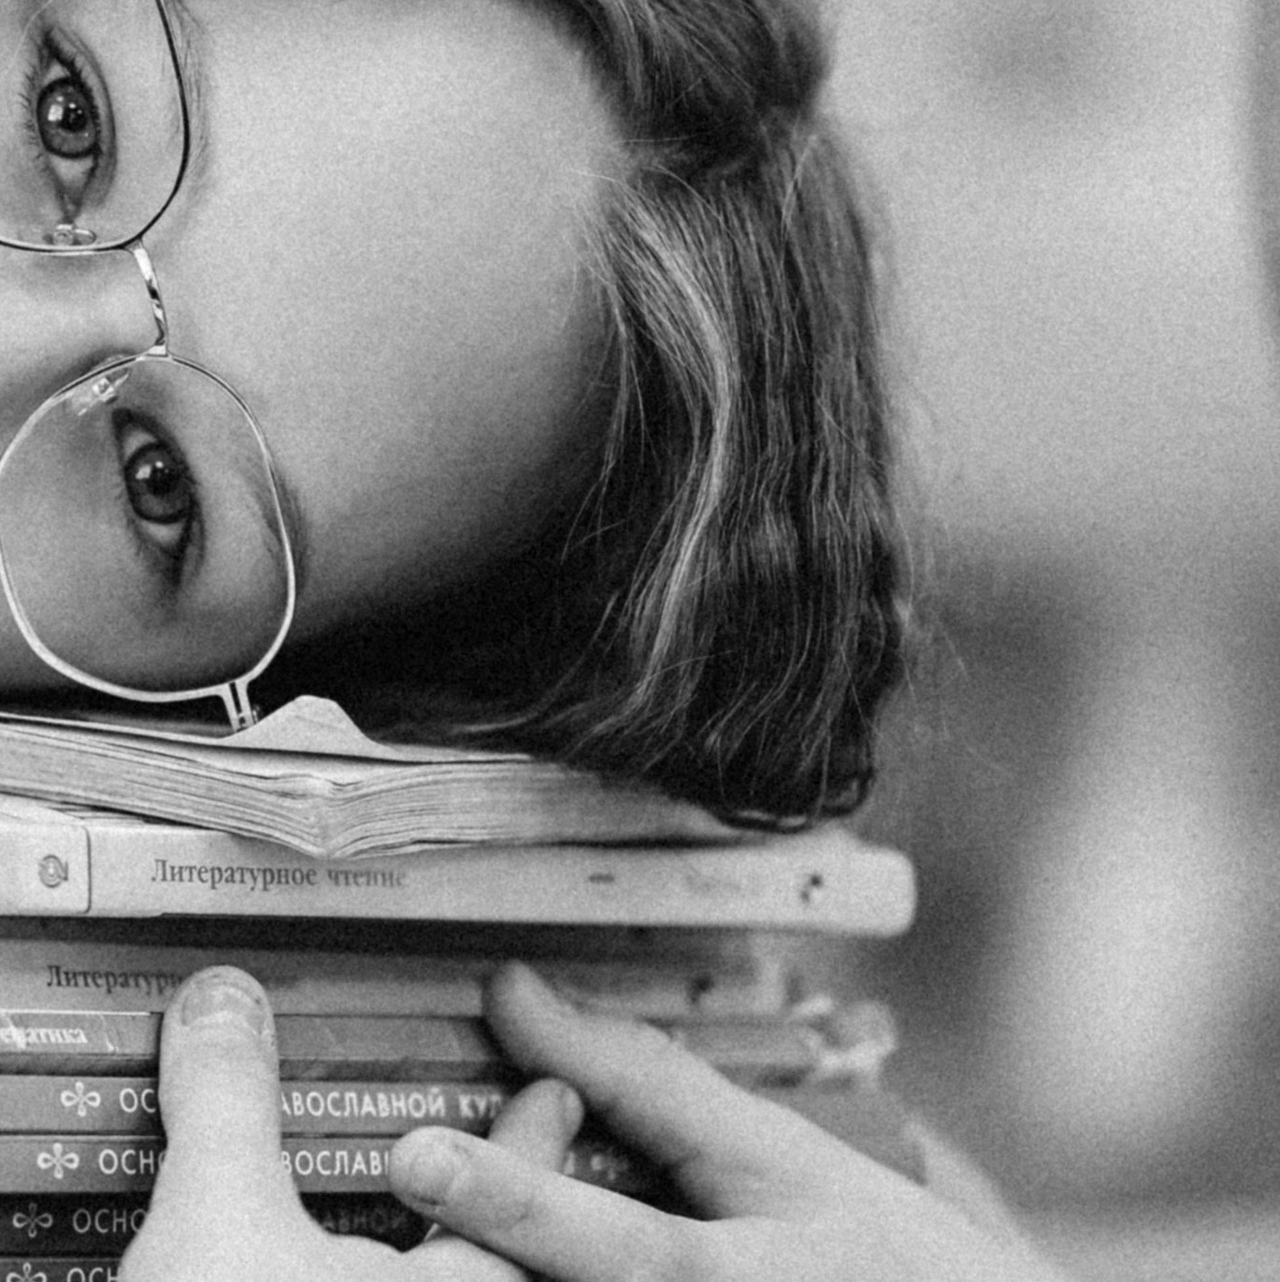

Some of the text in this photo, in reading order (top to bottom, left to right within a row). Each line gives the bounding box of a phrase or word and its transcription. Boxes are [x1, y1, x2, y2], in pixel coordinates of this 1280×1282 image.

[150, 858, 405, 892] Литературное чтение
[119, 1087, 157, 1113] ОС
[280, 1149, 390, 1176] ВОСЛАВ
